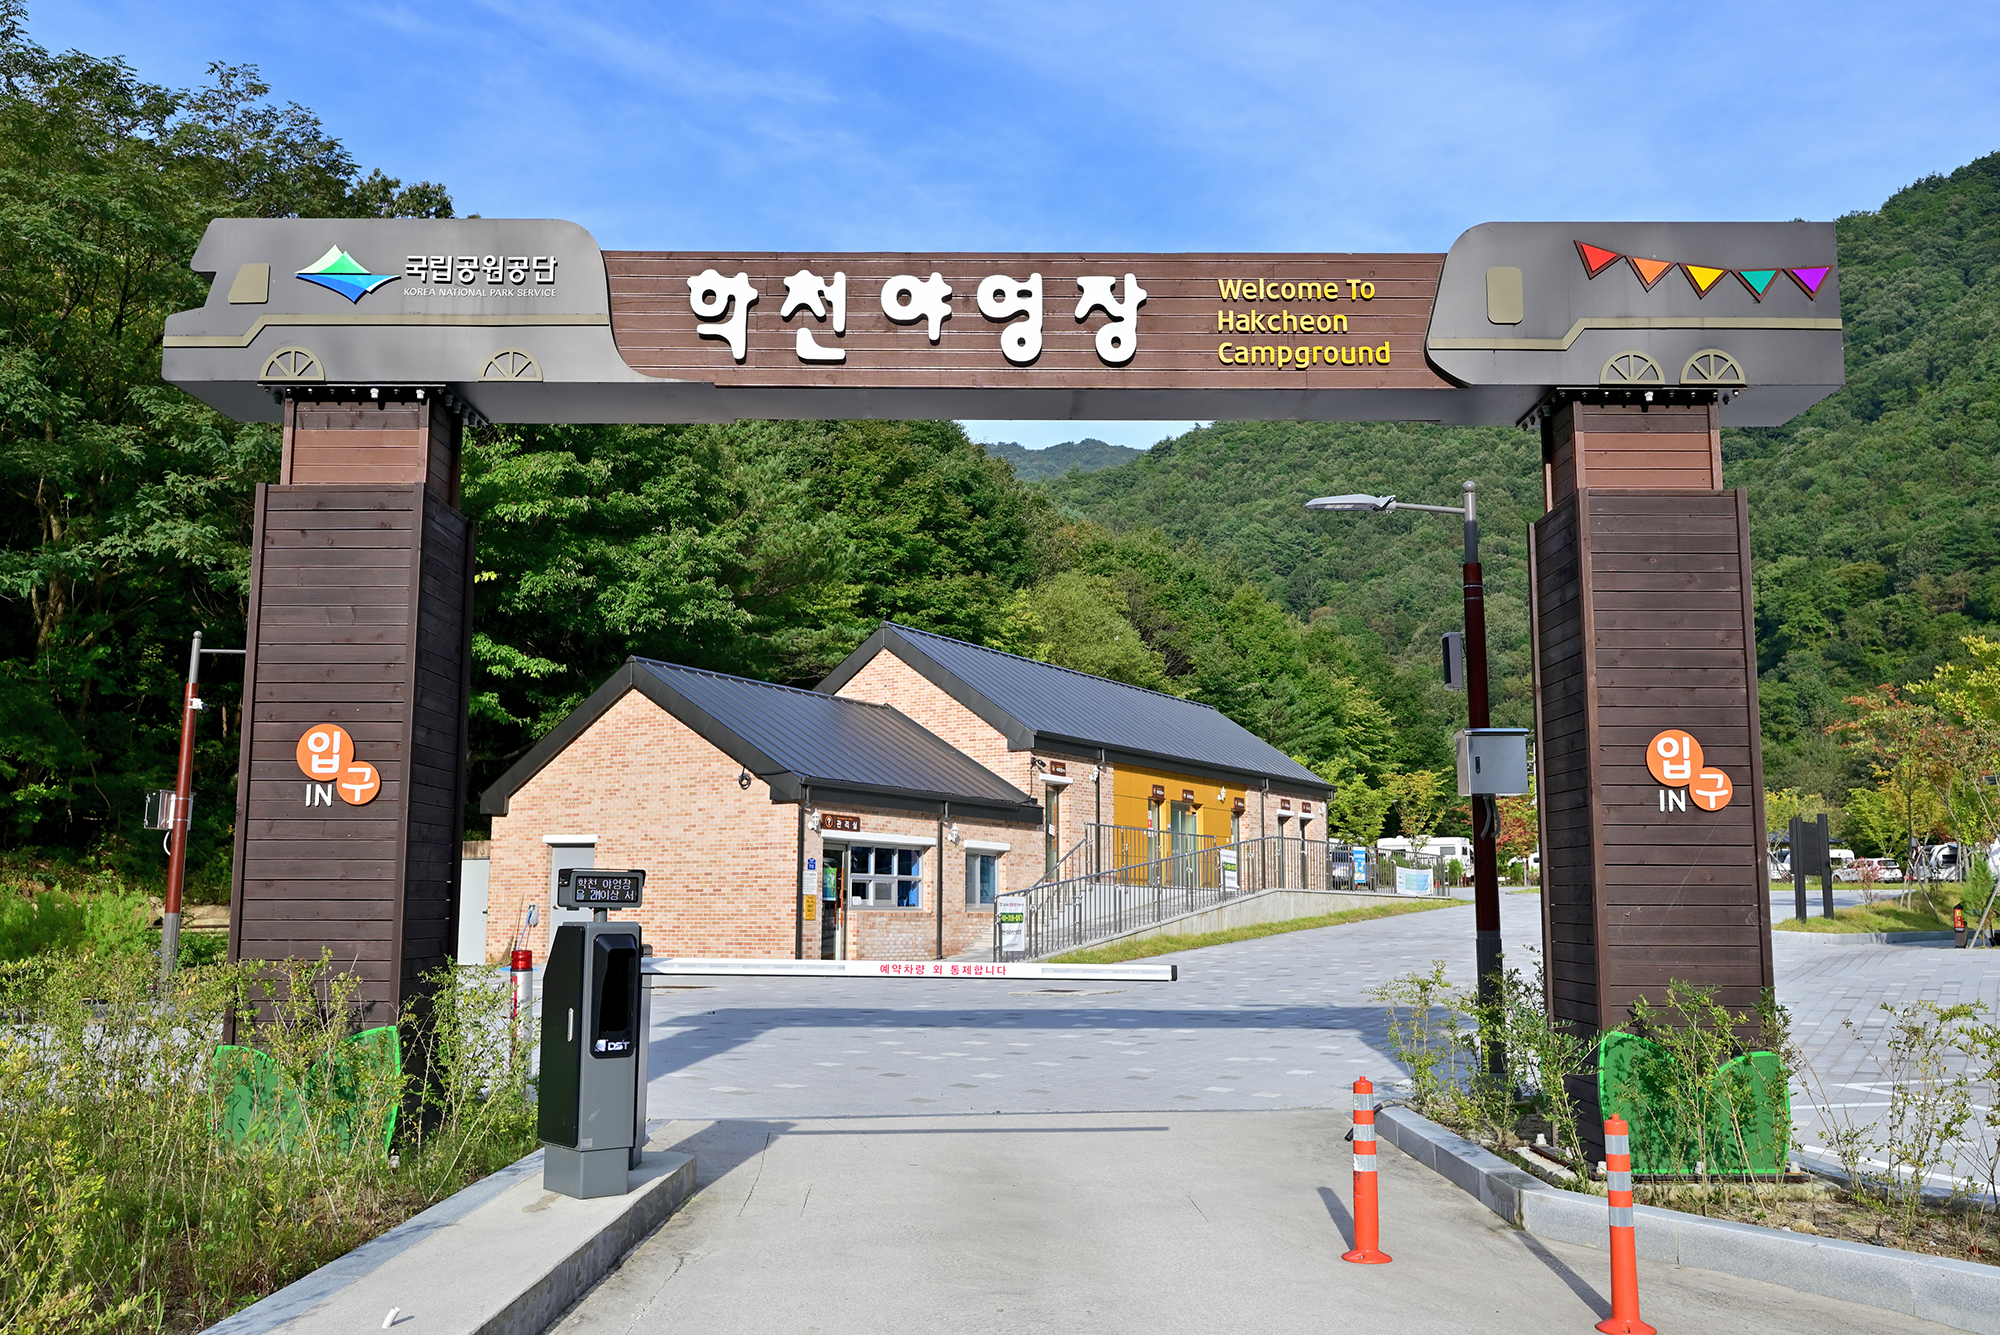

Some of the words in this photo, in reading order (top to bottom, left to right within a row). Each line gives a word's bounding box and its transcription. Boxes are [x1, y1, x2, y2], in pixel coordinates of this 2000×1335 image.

[404, 254, 559, 285] 국립공원공단
[403, 288, 436, 297] KOREA
[438, 288, 487, 298] NATIONAL
[489, 288, 515, 298] PARK
[516, 288, 557, 298] SERVICE
[1217, 277, 1340, 301] Welcome
[1346, 278, 1376, 301] To
[1217, 309, 1349, 333] Hakcheon
[1217, 341, 1391, 370] Campground
[307, 730, 376, 803] 입구
[1656, 736, 1730, 810] 입구
[304, 783, 333, 808] IN
[1658, 788, 1687, 813] IN
[602, 878, 632, 890] 야영장
[879, 964, 926, 976] 예약차량
[932, 964, 943, 975] 외
[949, 965, 1007, 976] 통제합니다
[607, 1041, 630, 1051] DST
